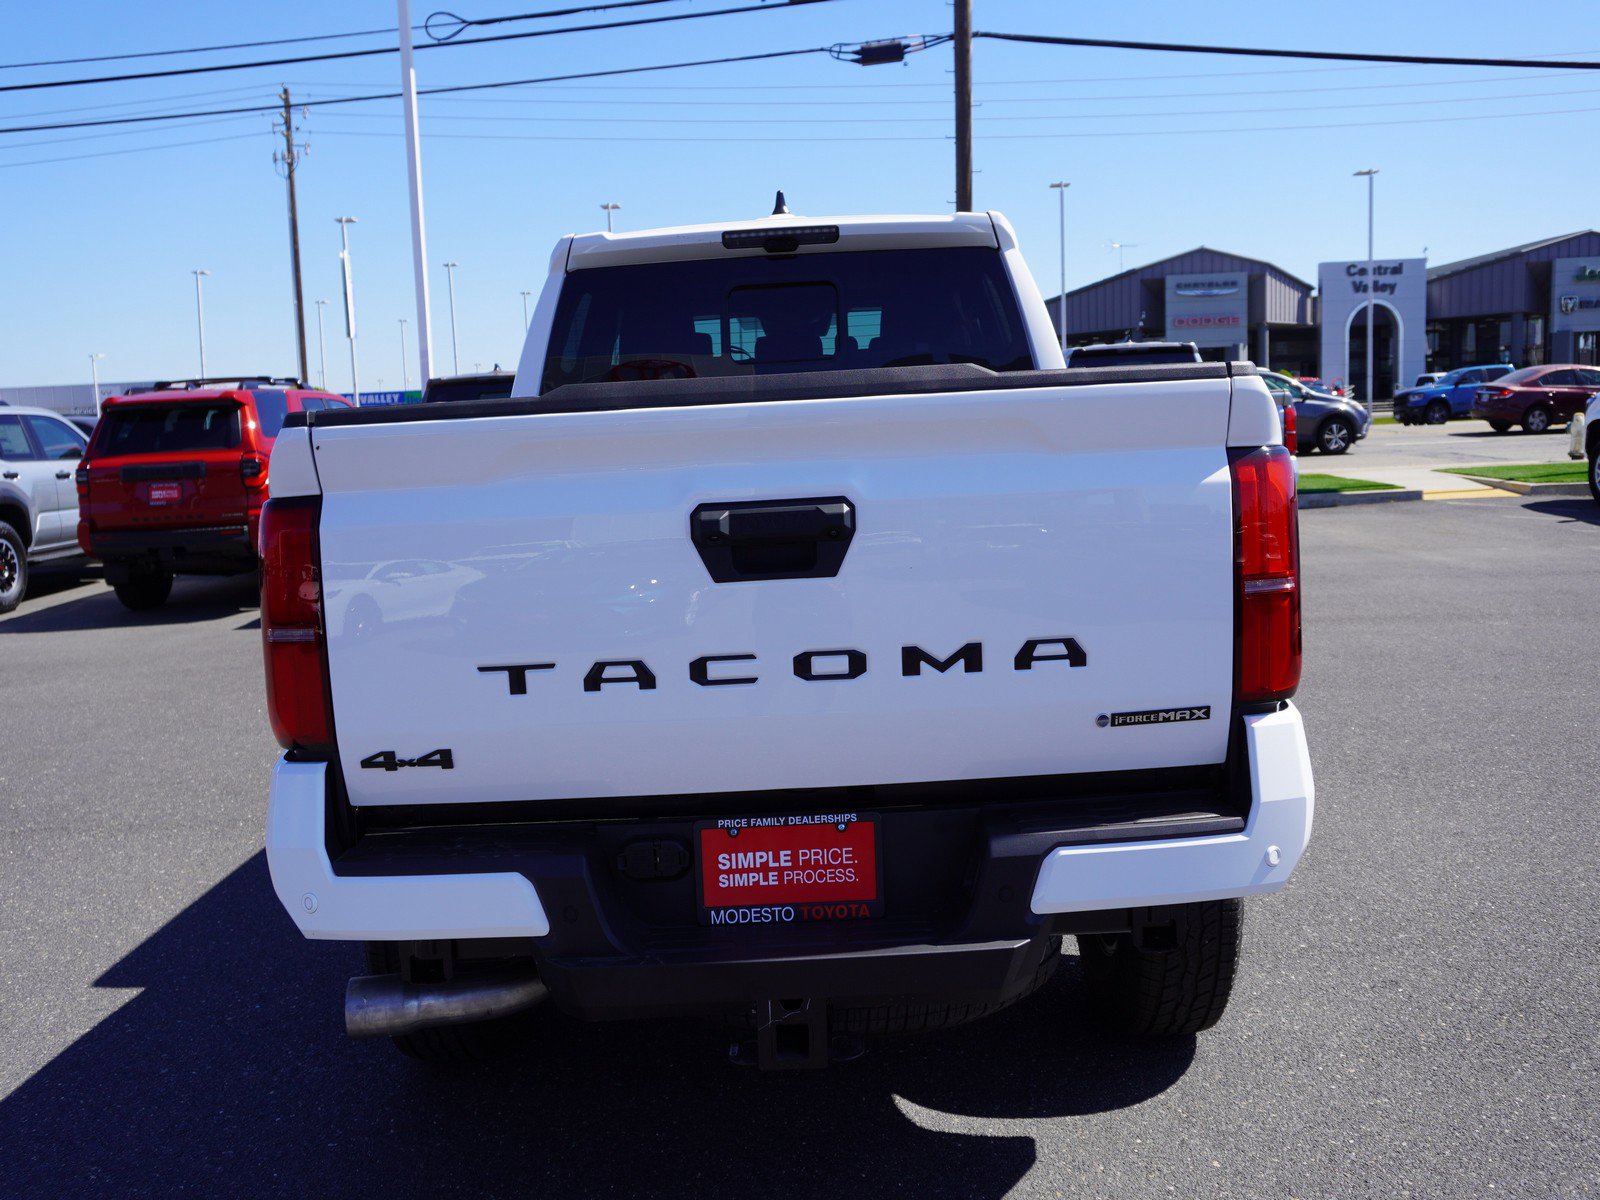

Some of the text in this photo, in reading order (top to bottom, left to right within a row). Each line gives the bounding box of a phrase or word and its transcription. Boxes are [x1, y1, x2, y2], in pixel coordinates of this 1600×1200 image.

[1175, 281, 1238, 289] CHRYSLER
[1174, 316, 1240, 328] DODGE
[360, 393, 400, 405] VALLEY
[477, 637, 1087, 695] TACOMA
[718, 813, 857, 828] PRICE FAMILY DEALERSHIPS
[717, 847, 858, 870] SIMPLE PRICE.
[718, 868, 859, 888] SIMPLE PROCESS.
[711, 904, 871, 925] MODESTO TOYOTA
